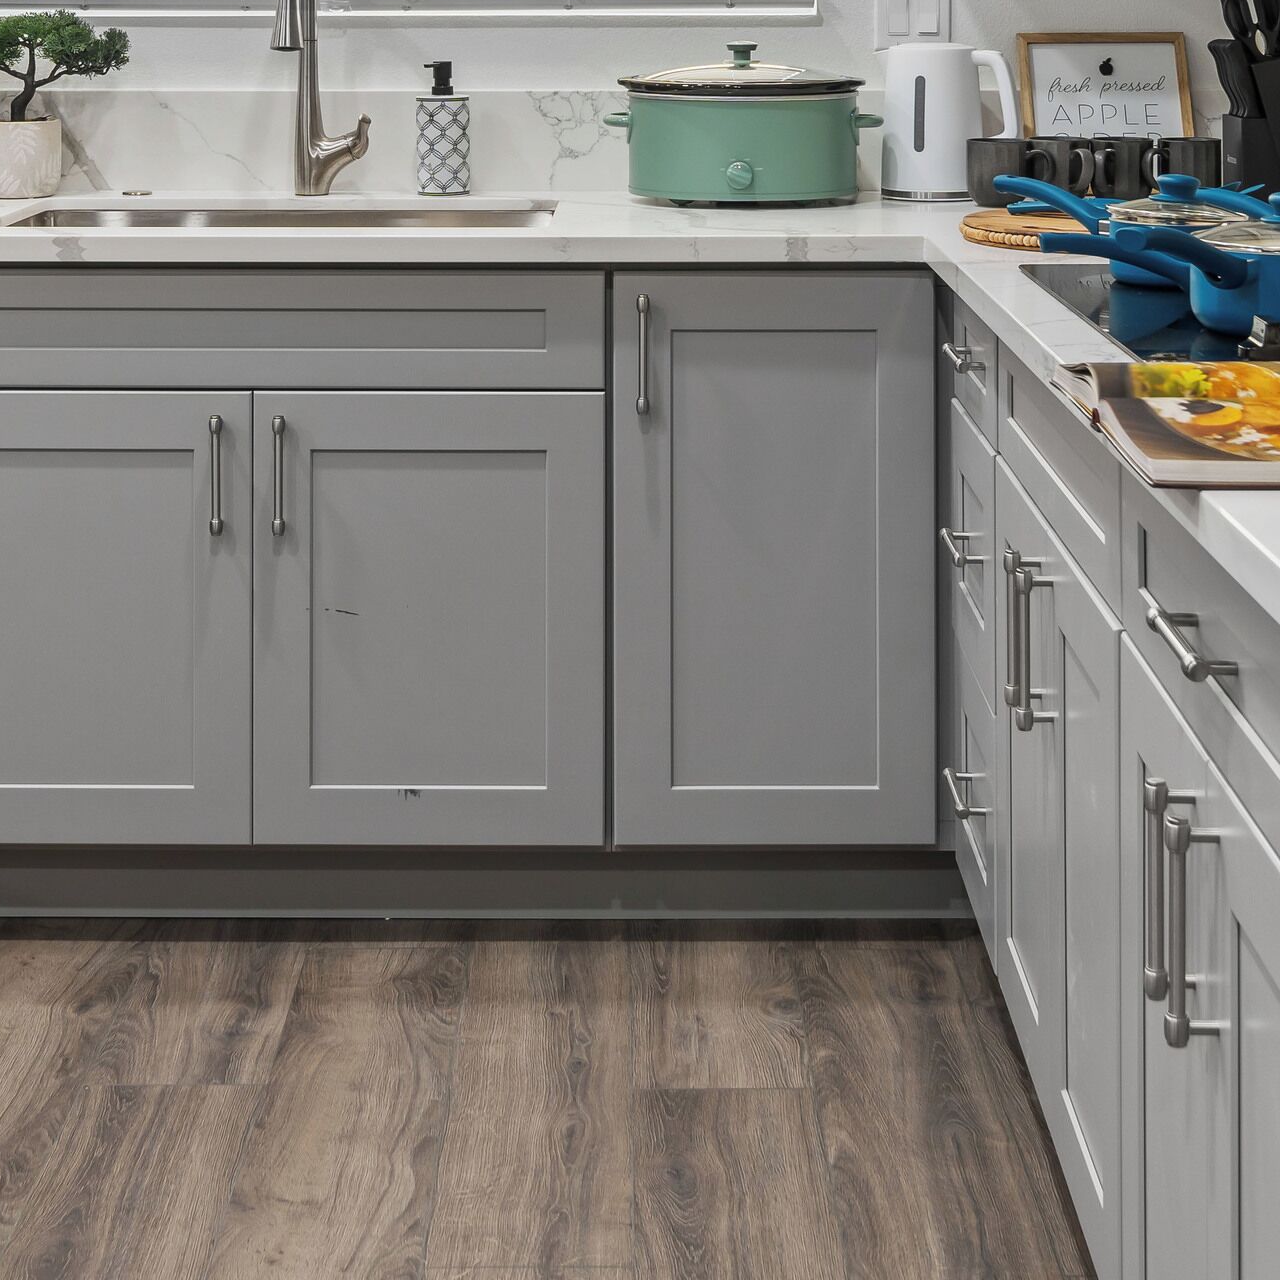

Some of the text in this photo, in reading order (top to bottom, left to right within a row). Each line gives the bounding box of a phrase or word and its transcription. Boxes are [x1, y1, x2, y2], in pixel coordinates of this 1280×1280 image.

[1048, 75, 1166, 102] fresh pressed
[1051, 103, 1161, 126] APPLE
